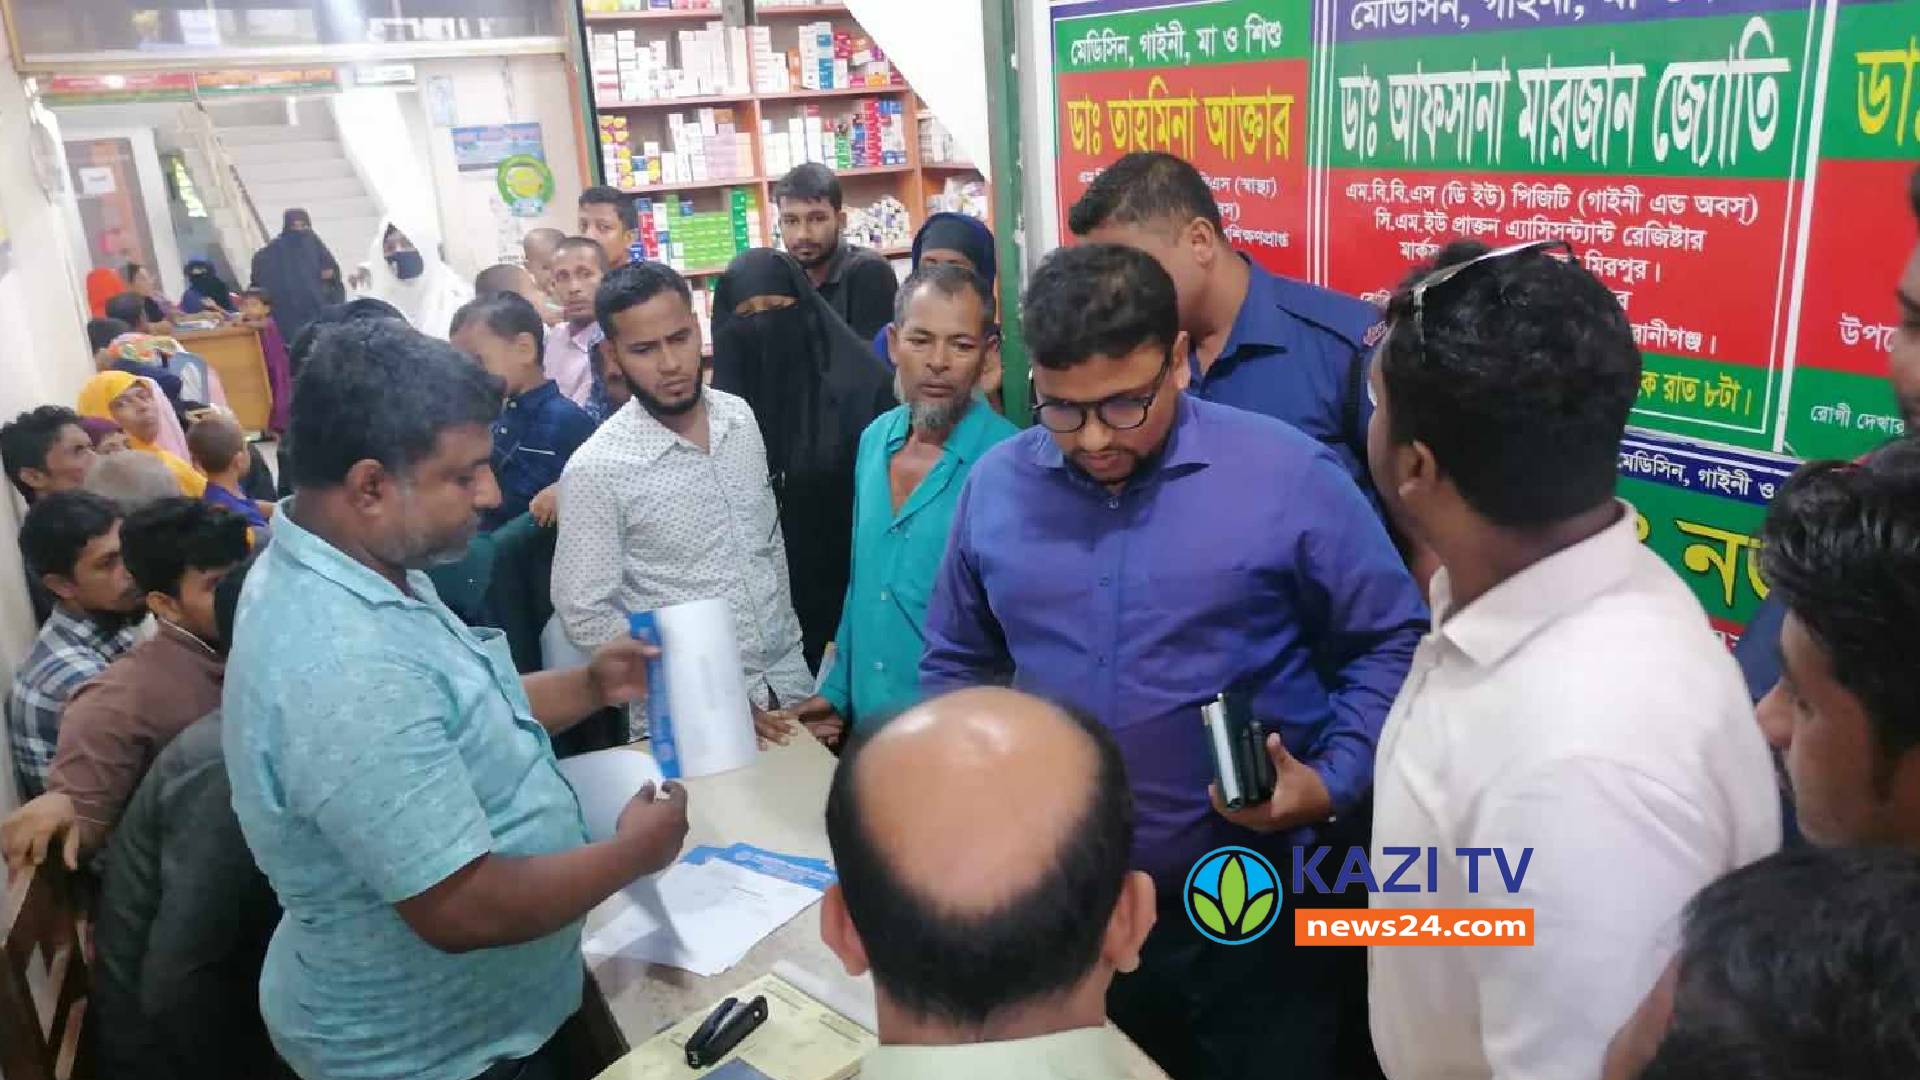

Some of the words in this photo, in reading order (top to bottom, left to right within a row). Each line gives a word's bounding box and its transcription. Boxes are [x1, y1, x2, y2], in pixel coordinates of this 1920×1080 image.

[1071, 29, 1135, 68] মেডিসিন,
[1139, 20, 1191, 65] গাইনী,
[1196, 24, 1218, 57] মা
[1223, 27, 1238, 52] ও
[1244, 13, 1283, 53] শিশু
[1338, 63, 1381, 163] ডাঃ
[1387, 55, 1511, 165] আফসানা
[1517, 50, 1646, 168] মারজান
[1653, 16, 1791, 168] জ্যোতি
[1067, 92, 1101, 155] ডাঃ
[1107, 74, 1200, 160] তাহমিনা
[1203, 85, 1295, 160] আক্তার
[1346, 177, 1438, 204] এম.বি.বি.এস
[1441, 180, 1468, 210] (ডি
[1471, 180, 1506, 213] ইউ)
[1511, 182, 1573, 210] পিজিটি
[1579, 184, 1644, 218] (গাইনী
[1650, 193, 1688, 216] এন্ড
[1375, 206, 1449, 236] সি.এম.ইউ
[1663, 372, 1701, 404] রাত
[1698, 467, 1753, 496] গাইনী
